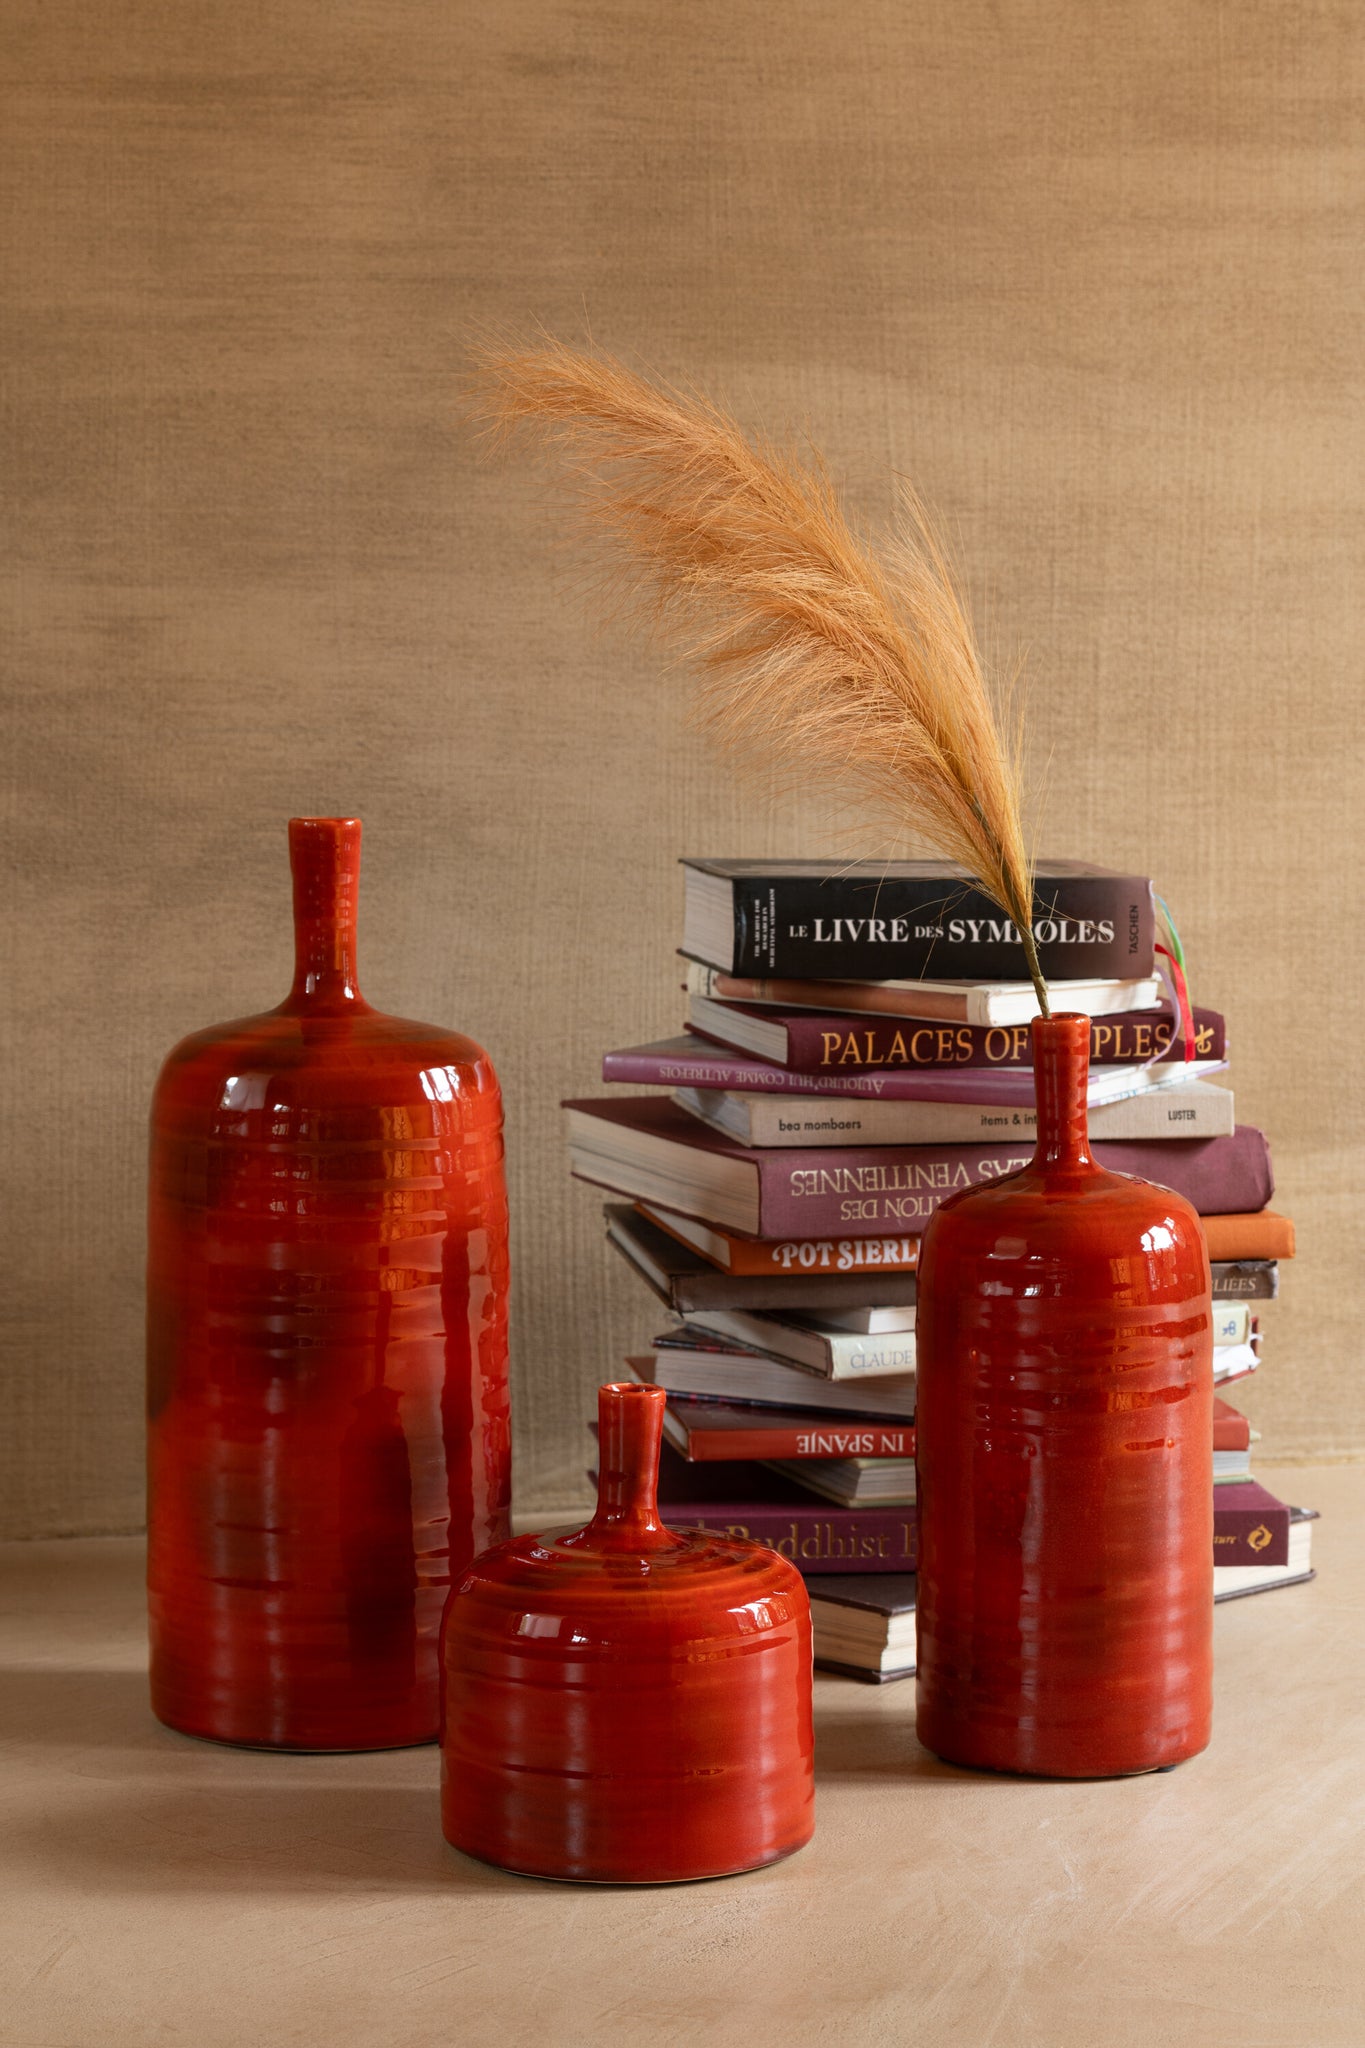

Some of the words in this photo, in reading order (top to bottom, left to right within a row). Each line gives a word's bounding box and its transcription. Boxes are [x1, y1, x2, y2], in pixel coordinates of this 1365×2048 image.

[789, 925, 808, 938] LE
[813, 918, 909, 942] LIVRE
[914, 925, 945, 938] DES
[1128, 904, 1139, 955] TASCHEN
[820, 1028, 974, 1065] PALACES
[984, 1026, 1028, 1062] OF
[1091, 1023, 1171, 1058] PLES
[778, 1118, 801, 1132] bea
[804, 1118, 862, 1132] mombaers
[980, 1114, 1009, 1126] items
[1012, 1114, 1021, 1125] &
[1168, 1109, 1197, 1121] LUSTER
[789, 1162, 973, 1197] VENITIENNES
[840, 1199, 879, 1221] DES
[1212, 1277, 1257, 1292] LIÉES
[850, 1350, 913, 1369] CLAUDE
[795, 1431, 875, 1454] SPANJE
[880, 1433, 904, 1452] IN
